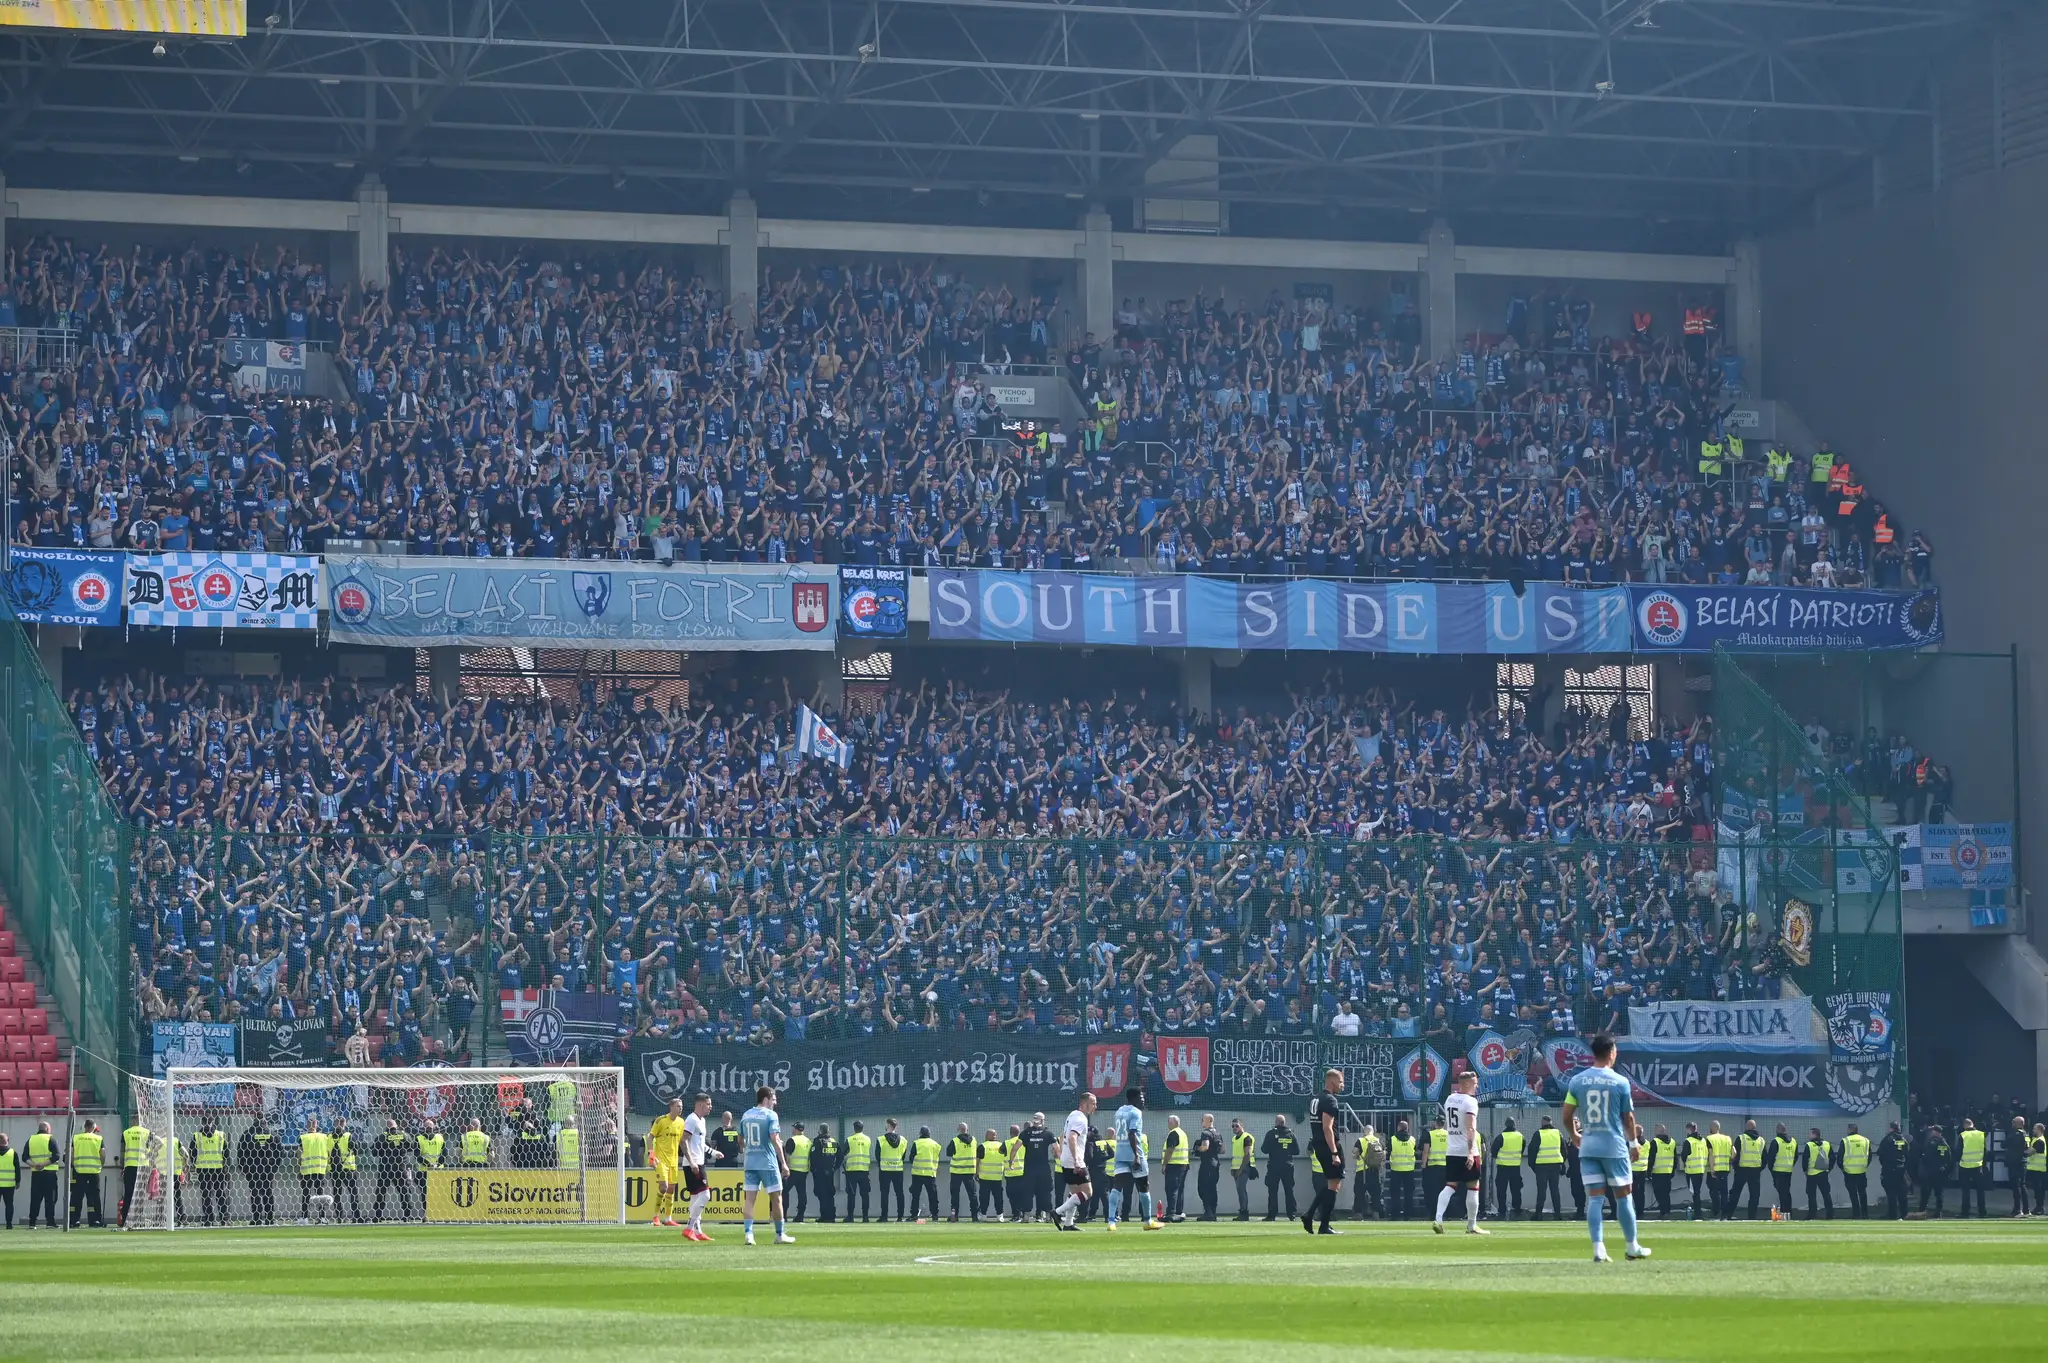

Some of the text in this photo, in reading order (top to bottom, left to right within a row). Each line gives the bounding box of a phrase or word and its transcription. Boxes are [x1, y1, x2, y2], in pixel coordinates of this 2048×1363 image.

[241, 371, 301, 392] LOVAN
[627, 575, 786, 624] FOTRI
[936, 578, 1183, 635] SOUTH
[1243, 590, 1429, 642] SIDE
[18, 612, 98, 625] ON TOUR
[1789, 599, 1895, 629] PATRIOTI
[421, 617, 457, 633] NAŠE
[631, 622, 665, 638] PRE
[676, 622, 736, 638] SLOVAN
[177, 1026, 232, 1038] SLOVAN
[246, 1016, 326, 1032] ULTRAS SLOVAN
[1213, 1039, 1288, 1064] SLOVAN
[700, 1052, 1080, 1094] ultras slovan pressburg
[1706, 1063, 1817, 1089] PEZINOK
[1446, 1106, 1460, 1129] 15
[1586, 1089, 1610, 1124] 81
[745, 1122, 760, 1146] 10
[488, 1182, 582, 1203] Slovnaft
